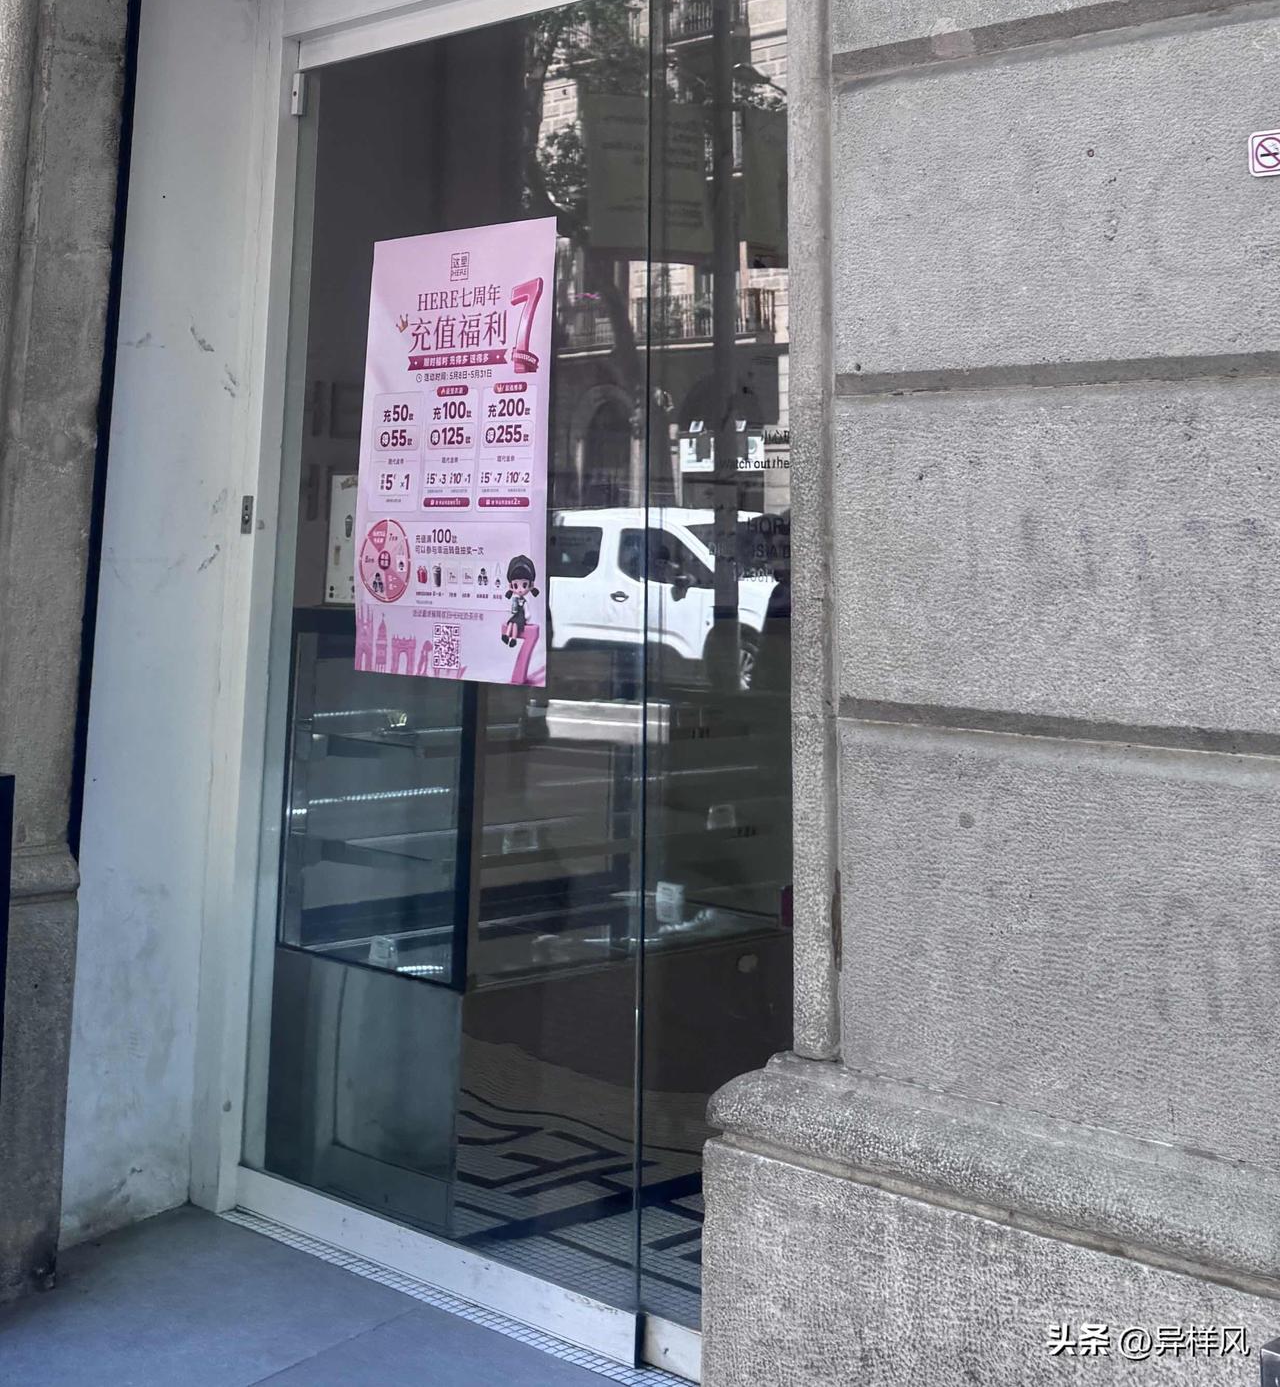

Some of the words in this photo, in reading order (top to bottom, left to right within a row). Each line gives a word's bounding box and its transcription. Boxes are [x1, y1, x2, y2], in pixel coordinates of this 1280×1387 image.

[417, 284, 501, 312] HERE七周年
[408, 310, 508, 353] 充值福利
